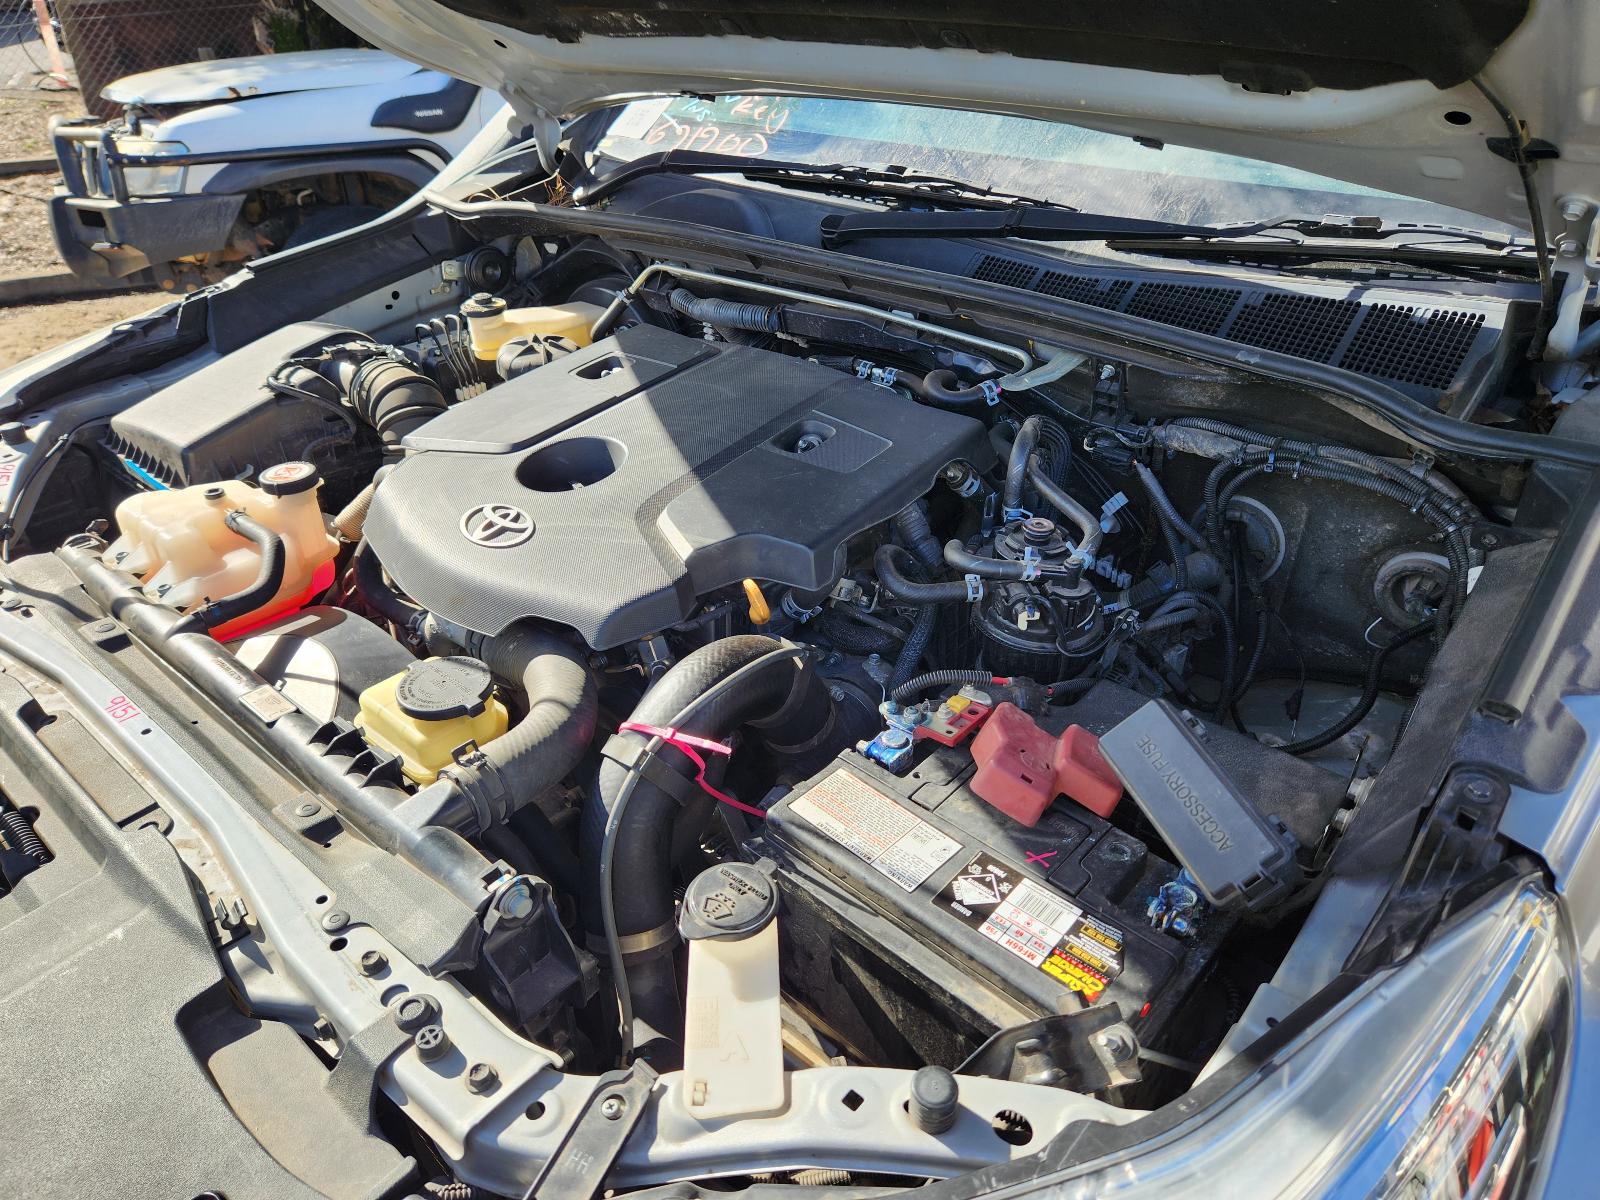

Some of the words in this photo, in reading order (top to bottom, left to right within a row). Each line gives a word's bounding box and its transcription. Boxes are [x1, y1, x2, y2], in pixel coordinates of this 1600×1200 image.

[104, 696, 141, 723] 9151
[1136, 733, 1169, 772] FUSE
[1162, 771, 1233, 852] ACCESSORY
[950, 901, 973, 917] DANGER
[1005, 938, 1037, 961] MF66H
[1053, 948, 1107, 985] BATTERIES
[1047, 955, 1104, 991] CHARGE
